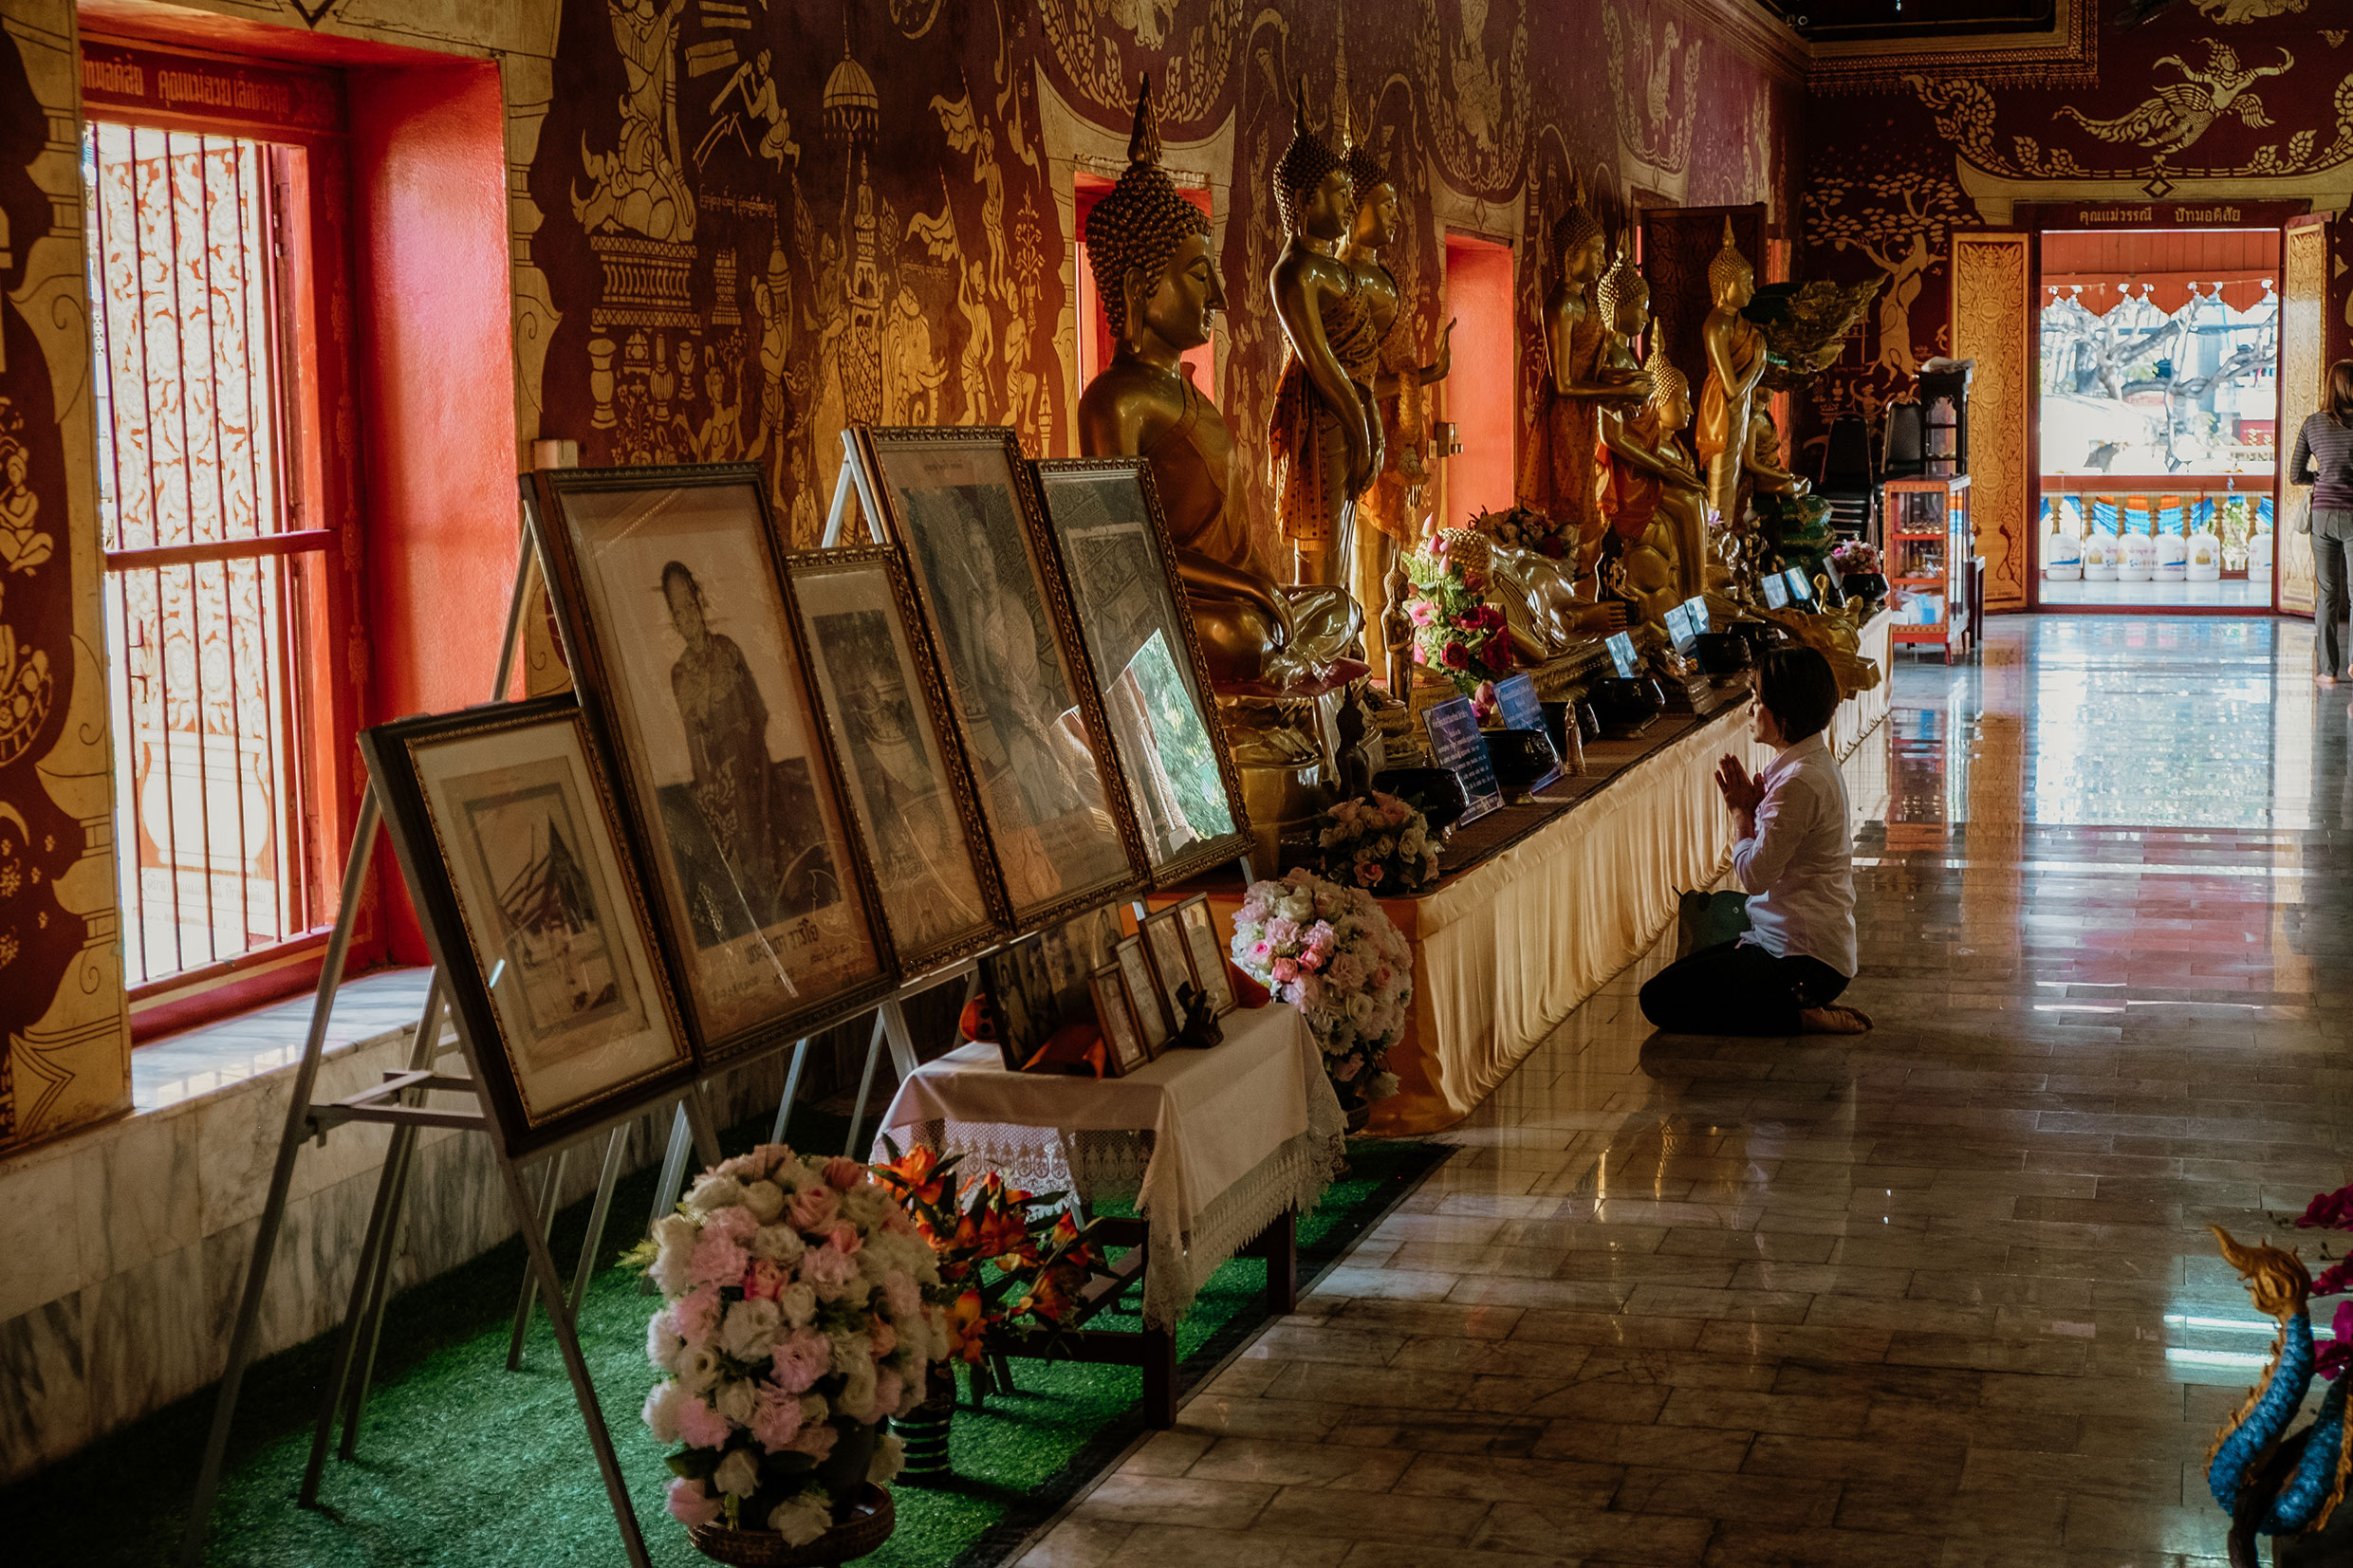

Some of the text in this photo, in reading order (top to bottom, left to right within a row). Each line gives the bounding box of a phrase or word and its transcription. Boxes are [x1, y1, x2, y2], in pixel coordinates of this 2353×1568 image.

[2080, 207, 2241, 225] คุณแม่วรรณี ปัทมอดิสัย
